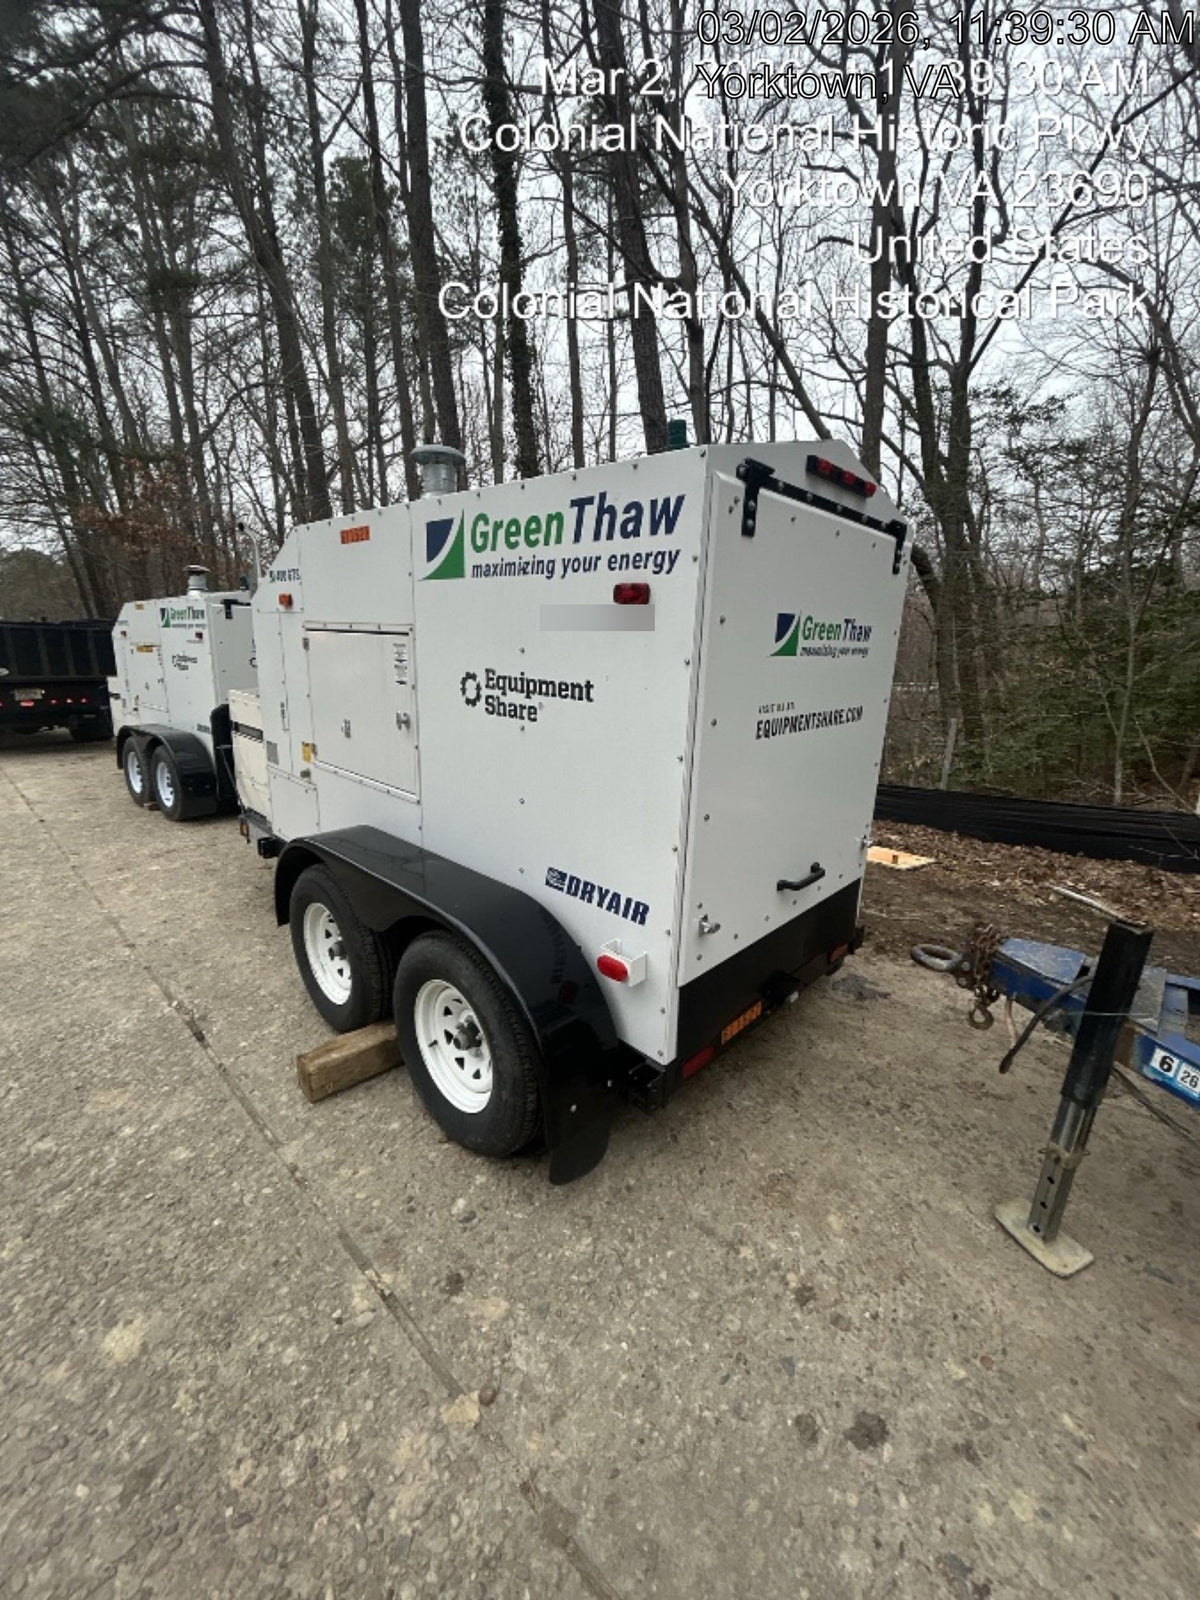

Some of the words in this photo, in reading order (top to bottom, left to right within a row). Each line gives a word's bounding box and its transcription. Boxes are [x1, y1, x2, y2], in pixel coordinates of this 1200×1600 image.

[471, 554, 555, 579] maximizing
[561, 555, 601, 579] your
[607, 549, 681, 575] energy
[484, 668, 594, 702] Equipment
[755, 705, 864, 740] EQUIPMENTSHARE.COM
[566, 874, 650, 927] DRYAIR
[1159, 1055, 1175, 1073] 6
